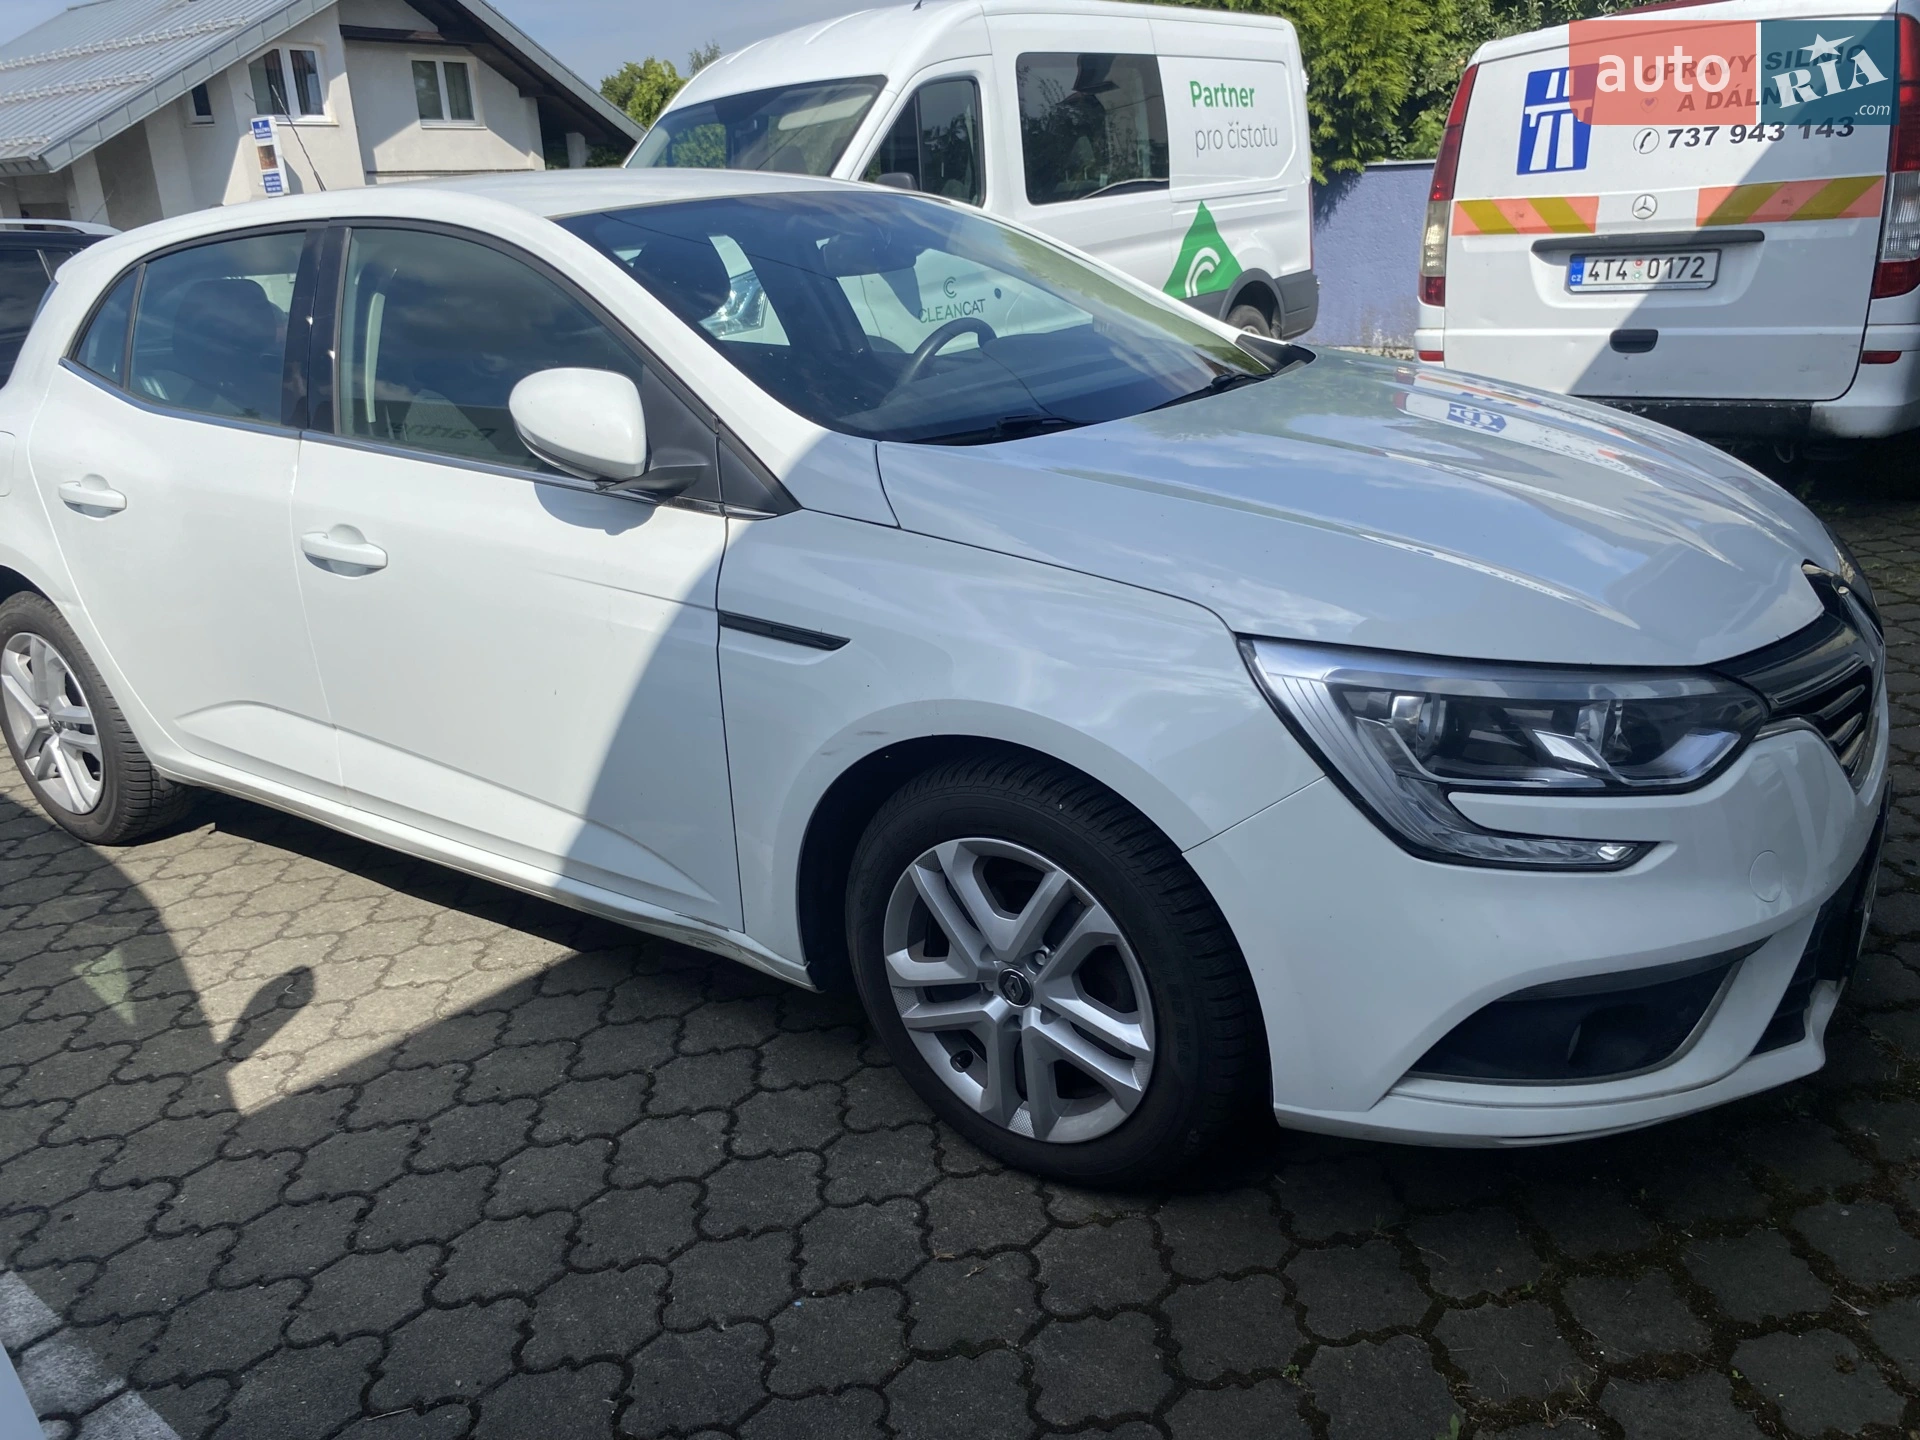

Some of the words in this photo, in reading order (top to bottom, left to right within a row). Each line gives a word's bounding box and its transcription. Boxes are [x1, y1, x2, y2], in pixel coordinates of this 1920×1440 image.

[1642, 54, 1757, 82] OPRAVY
[1189, 80, 1255, 108] Partner
[1677, 94, 1695, 113] A
[1195, 129, 1223, 158] pro
[1227, 121, 1278, 149] čistotu
[1668, 125, 1720, 149] 737
[1729, 121, 1785, 145] 943
[1798, 116, 1854, 140] 143
[1588, 258, 1628, 281] 4T4
[1647, 256, 1706, 280] 0172
[918, 298, 986, 324] CLEANCAT
